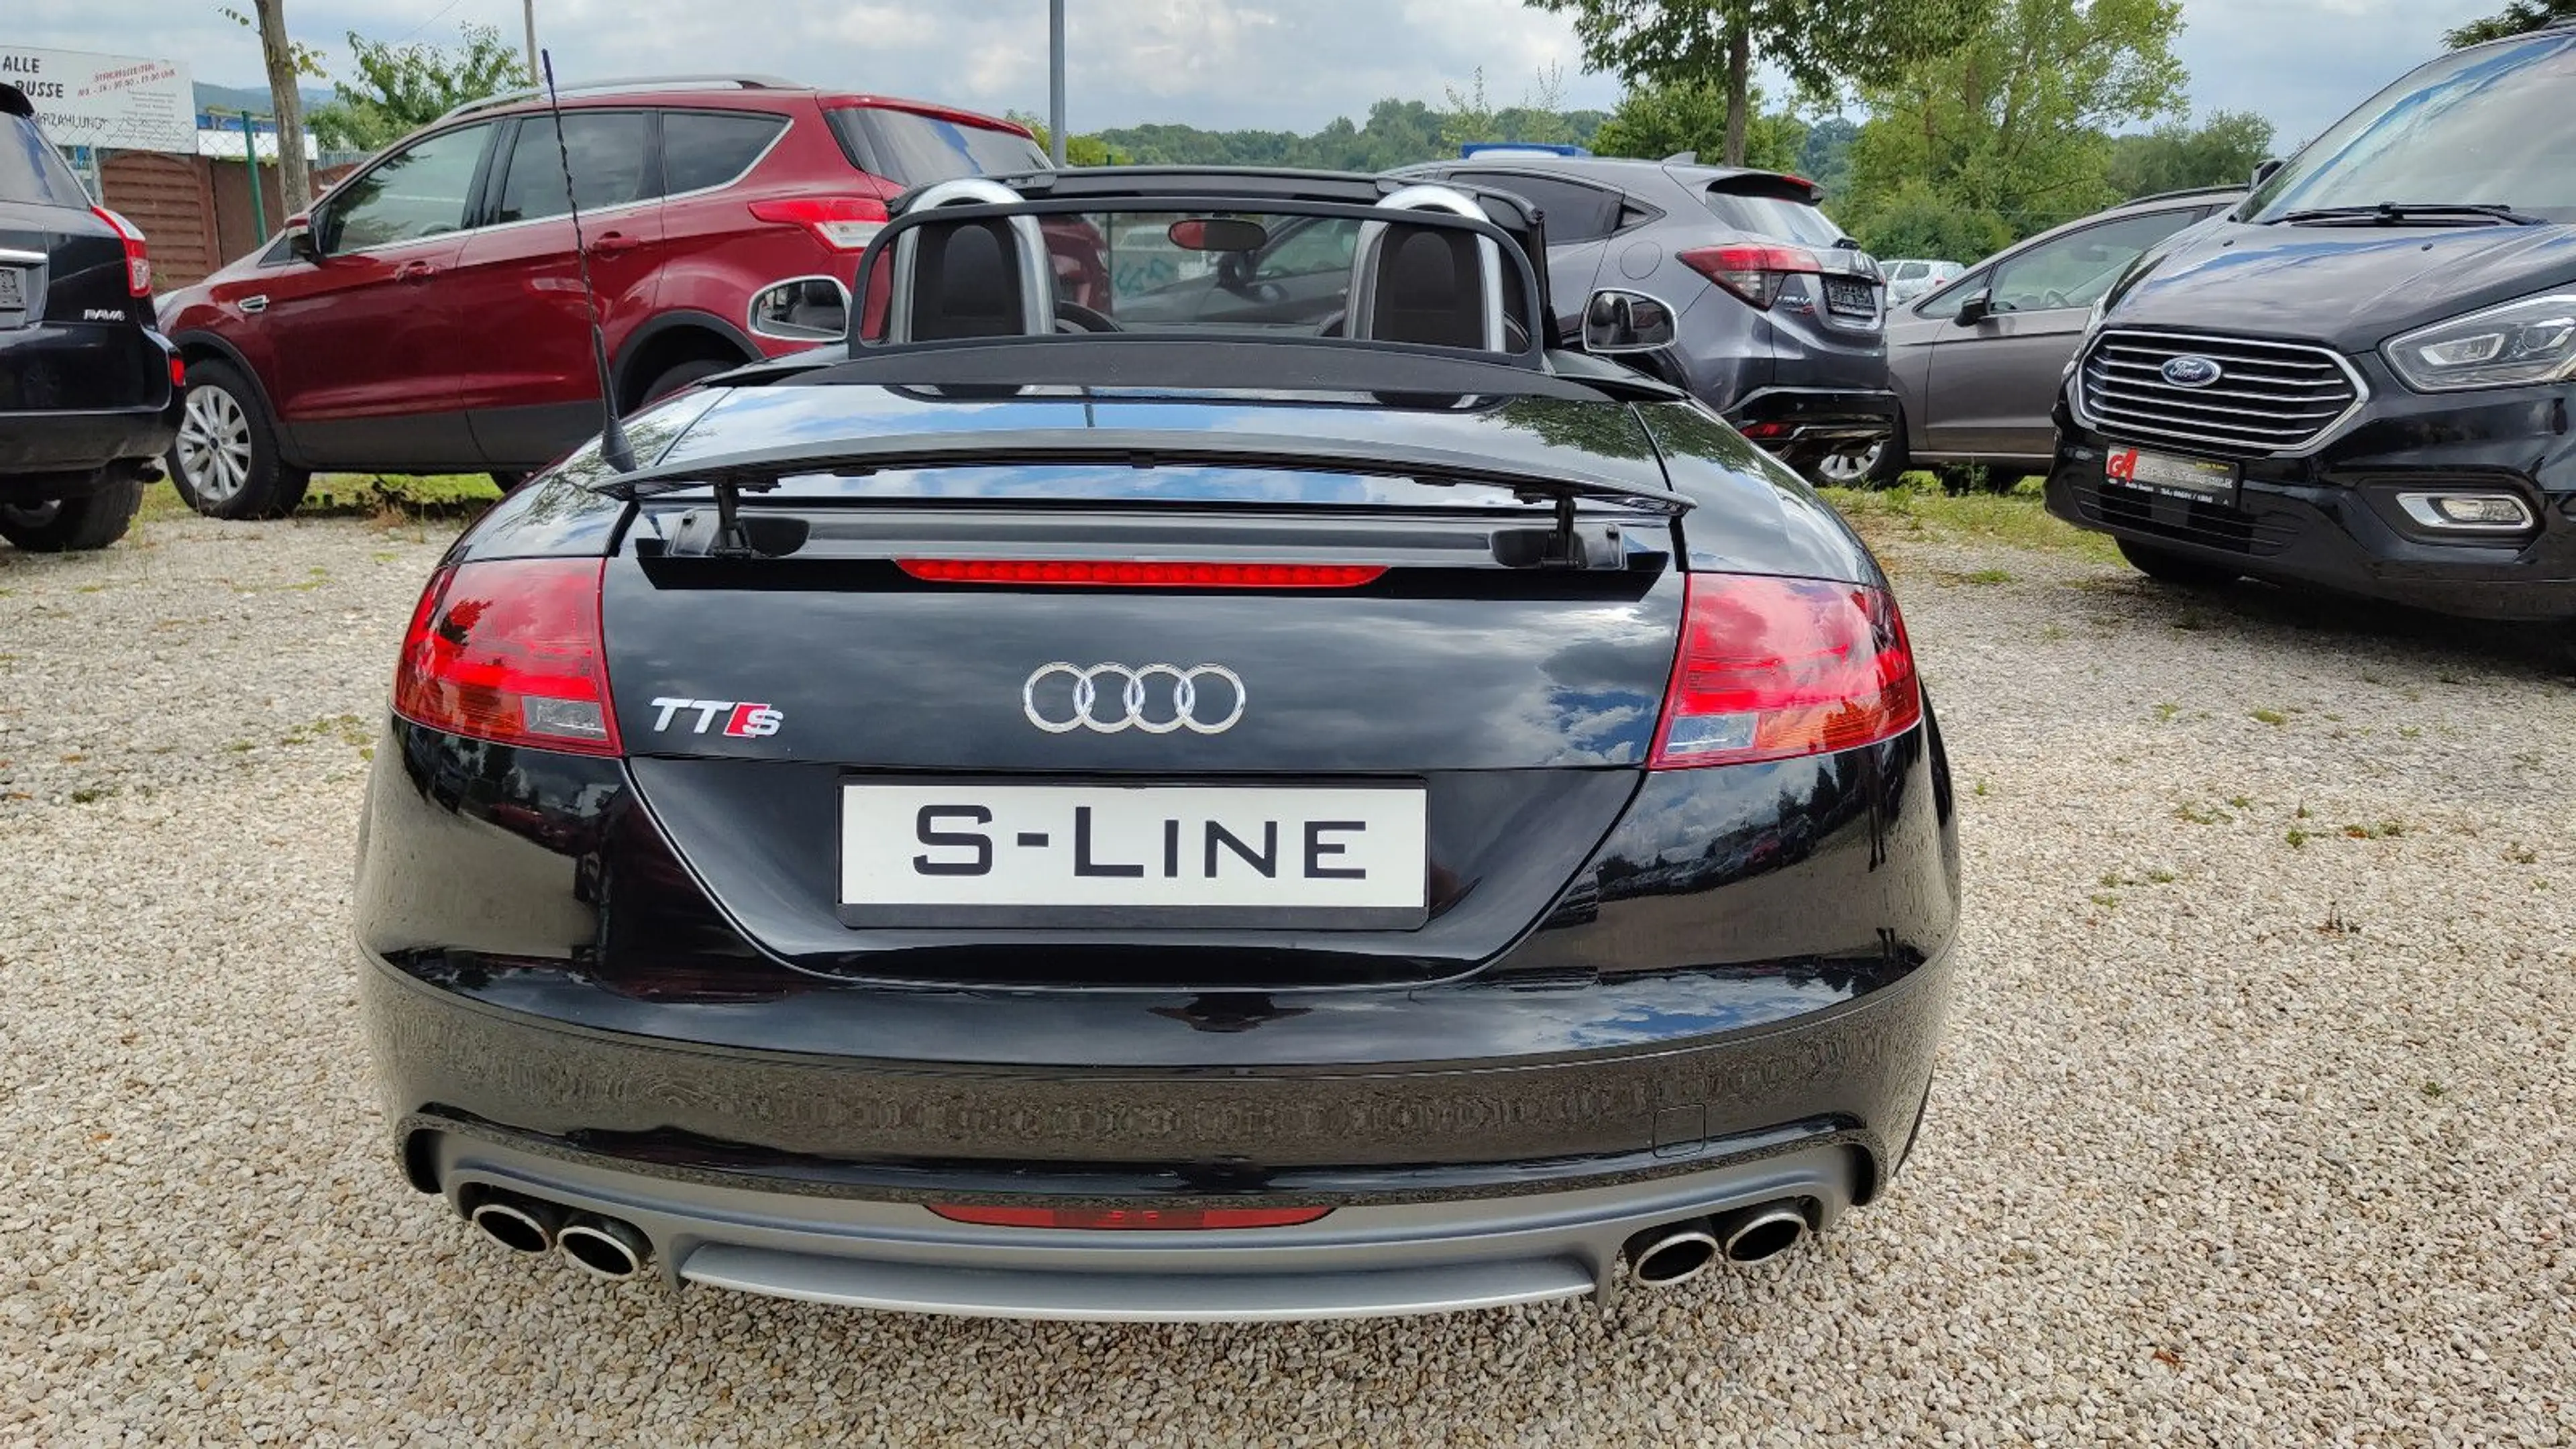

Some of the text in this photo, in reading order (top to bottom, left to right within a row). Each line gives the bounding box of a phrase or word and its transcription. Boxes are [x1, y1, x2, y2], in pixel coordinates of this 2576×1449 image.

[3, 54, 40, 73] ALLE
[83, 309, 125, 321] RAV4
[651, 697, 784, 738] TTS
[912, 804, 1366, 879] S-LINE
